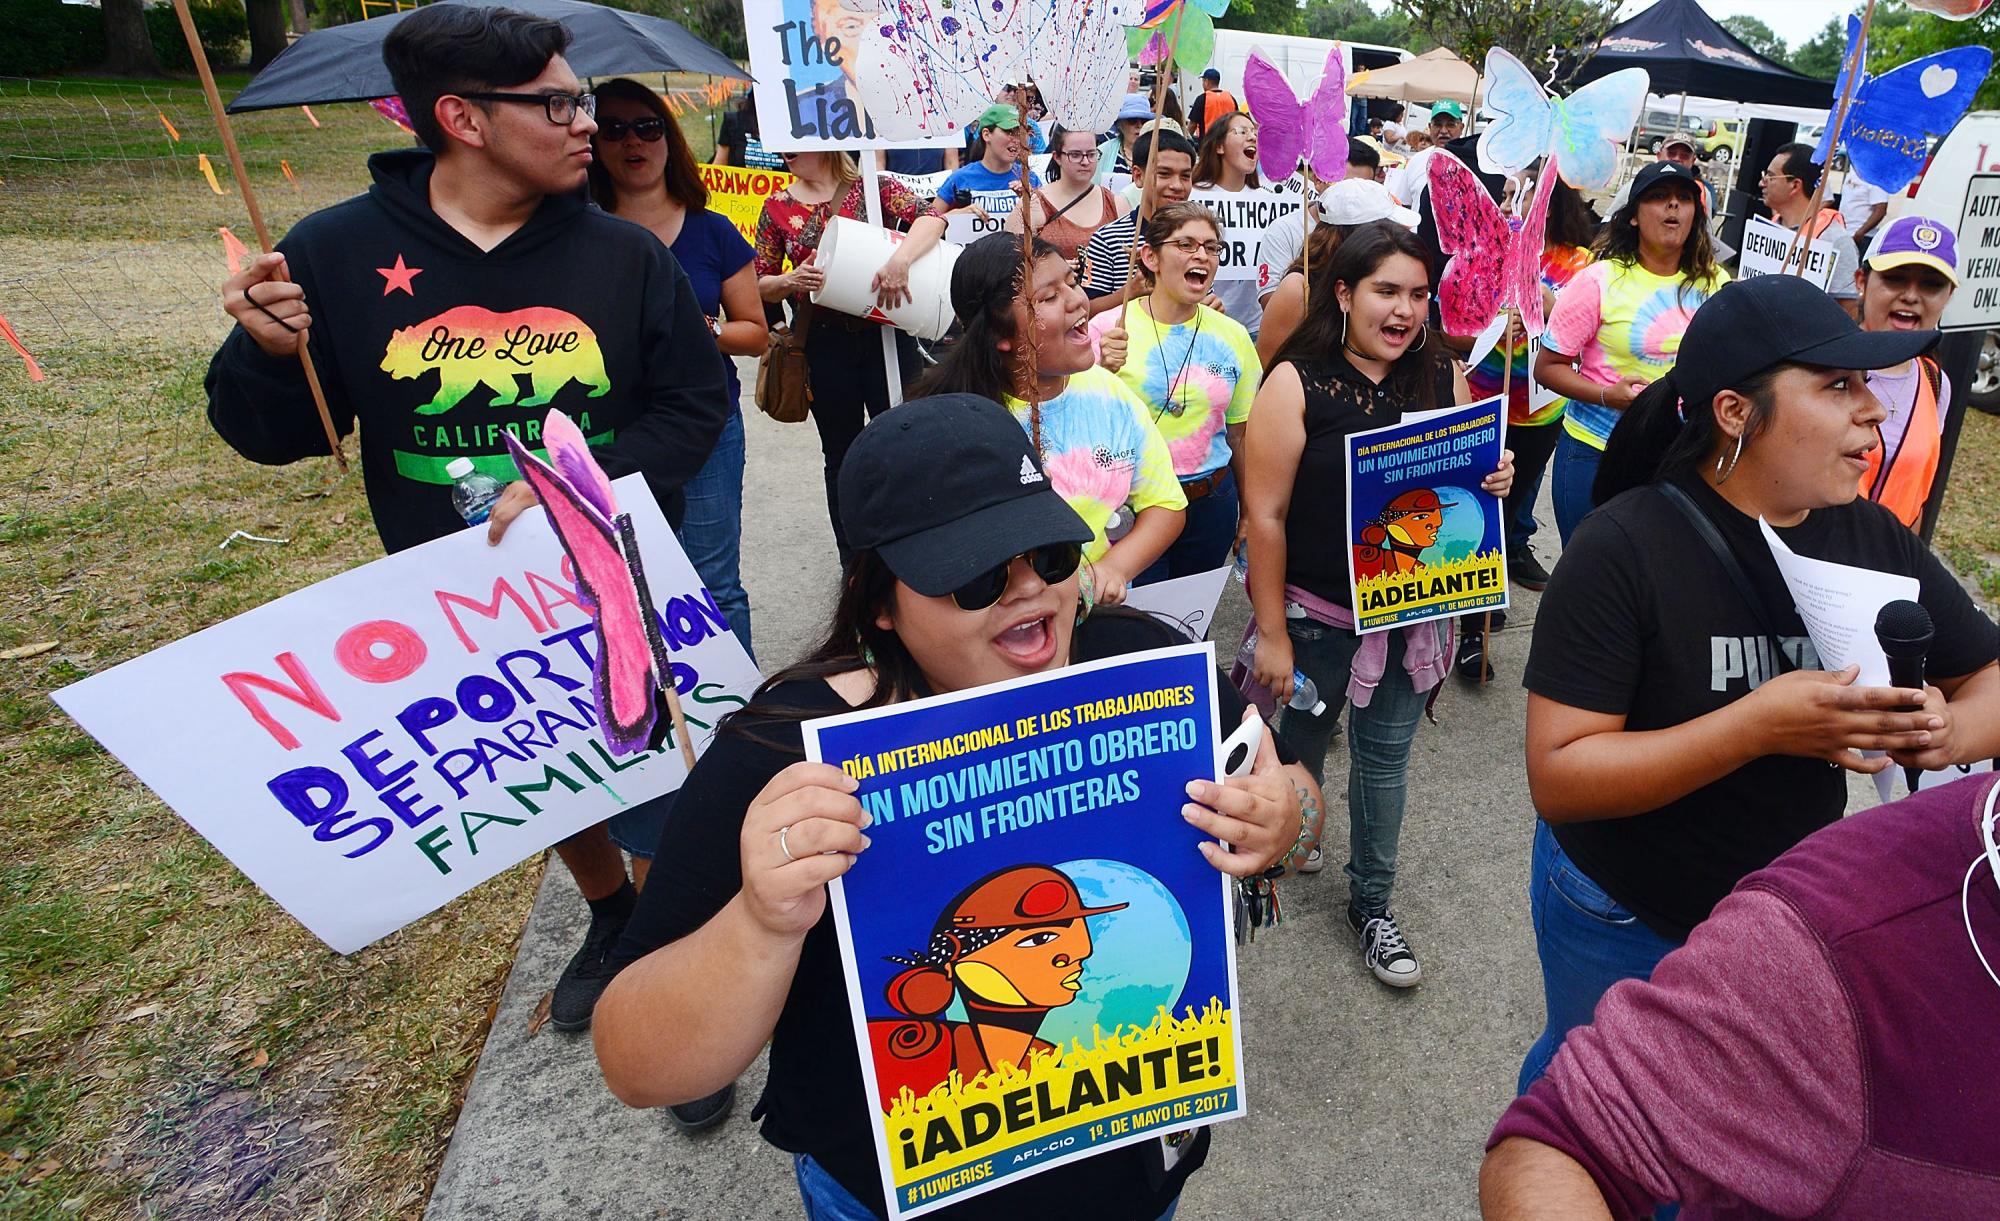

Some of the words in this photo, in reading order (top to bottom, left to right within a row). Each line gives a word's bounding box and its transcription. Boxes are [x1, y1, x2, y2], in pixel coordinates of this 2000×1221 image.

[773, 20, 844, 67] The
[698, 166, 794, 196] ARMWOR
[1746, 232, 1787, 261] DEFUND
[1258, 263, 1270, 287] 3
[1973, 287, 2000, 308] ONL
[421, 325, 487, 362] One
[495, 324, 580, 366] Love
[413, 411, 591, 449] CALIFORA
[1357, 446, 1369, 457] DÍA
[1371, 434, 1424, 454] INTERNACIONAL
[1425, 432, 1434, 442] DE
[1435, 427, 1448, 438] LOS
[1449, 413, 1496, 434] TRABAJADORES
[1358, 459, 1375, 474] UN
[1377, 440, 1451, 470] MOVIMIENTO
[1453, 427, 1496, 452] OBRERO
[1384, 469, 1404, 484] SIN
[1406, 452, 1472, 480] FRONTERAS
[1361, 567, 1499, 612] ¡ADELANTE!
[1406, 608, 1433, 617] AFL-CIO
[1448, 602, 1457, 611] DE
[1458, 598, 1476, 610] MAYO
[1476, 597, 1485, 606] DE
[1485, 594, 1502, 605] 2017
[222, 619, 428, 752] NO
[266, 588, 731, 827] DEPORTION
[842, 753, 876, 781] DÍA
[877, 723, 1015, 775] INTERNACIONAL
[1016, 716, 1039, 740] DE
[1041, 708, 1072, 733] LOS
[1074, 685, 1195, 725] TRABAJADORES
[415, 683, 748, 876] FAMILAS
[900, 739, 1084, 818] MOVIMIENTO
[1089, 717, 1197, 766] OBRERO
[925, 811, 975, 854] SIN
[980, 769, 1141, 839] FRONTERAS
[900, 1036, 1221, 1170] ¡ADELANTE!
[907, 1159, 994, 1204] #1UWERISE
[1013, 1136, 1075, 1164] AFL-CIO
[1111, 1117, 1130, 1137] DE
[1132, 1107, 1171, 1130] MAYO
[1174, 1103, 1192, 1119] DE
[1194, 1093, 1229, 1114] 2017
